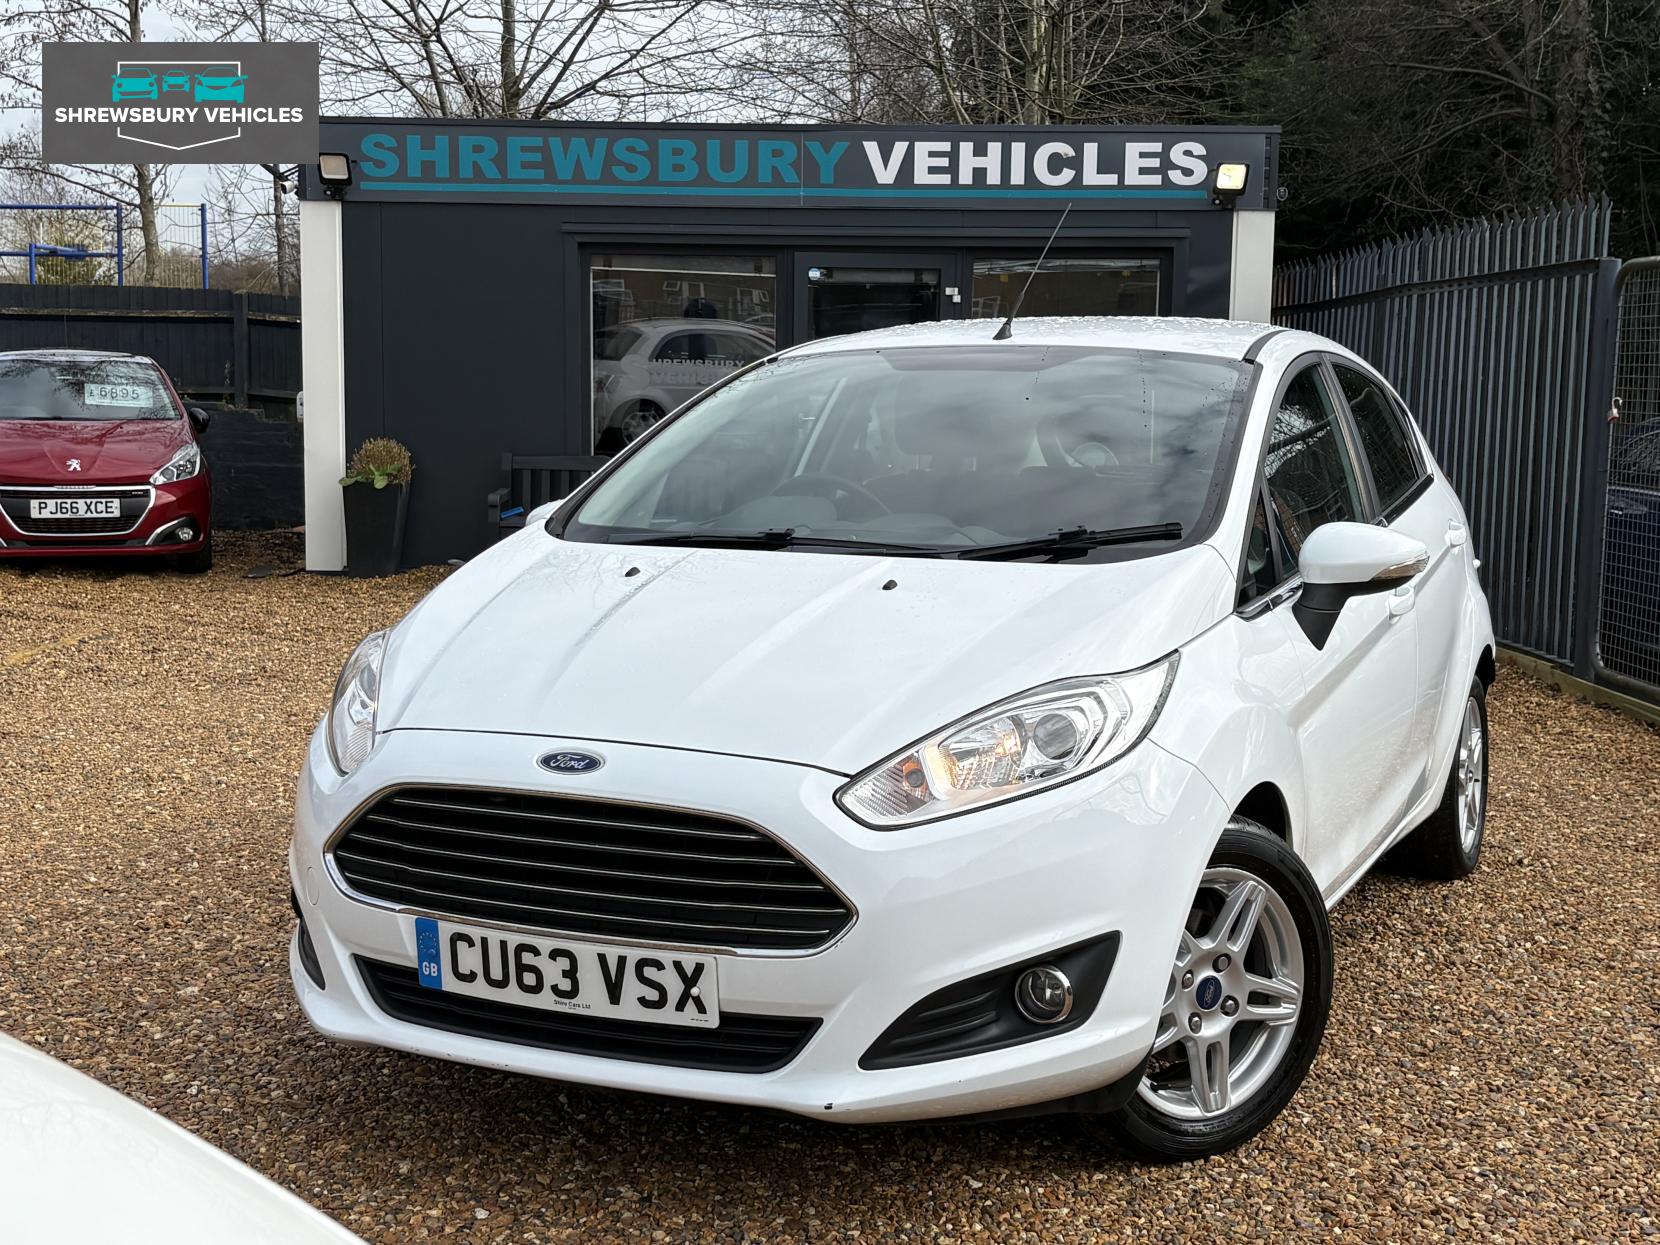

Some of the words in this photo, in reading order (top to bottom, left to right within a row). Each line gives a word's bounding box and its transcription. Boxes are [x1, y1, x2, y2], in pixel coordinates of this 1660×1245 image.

[359, 133, 849, 185] SHREWSBURY
[862, 140, 1208, 186] VEHICLES
[38, 501, 79, 515] PJ66
[84, 501, 114, 514] XCE
[550, 754, 590, 769] Ford
[422, 961, 438, 977] GB
[449, 932, 580, 1000] CU63
[597, 952, 707, 1015] VSX
